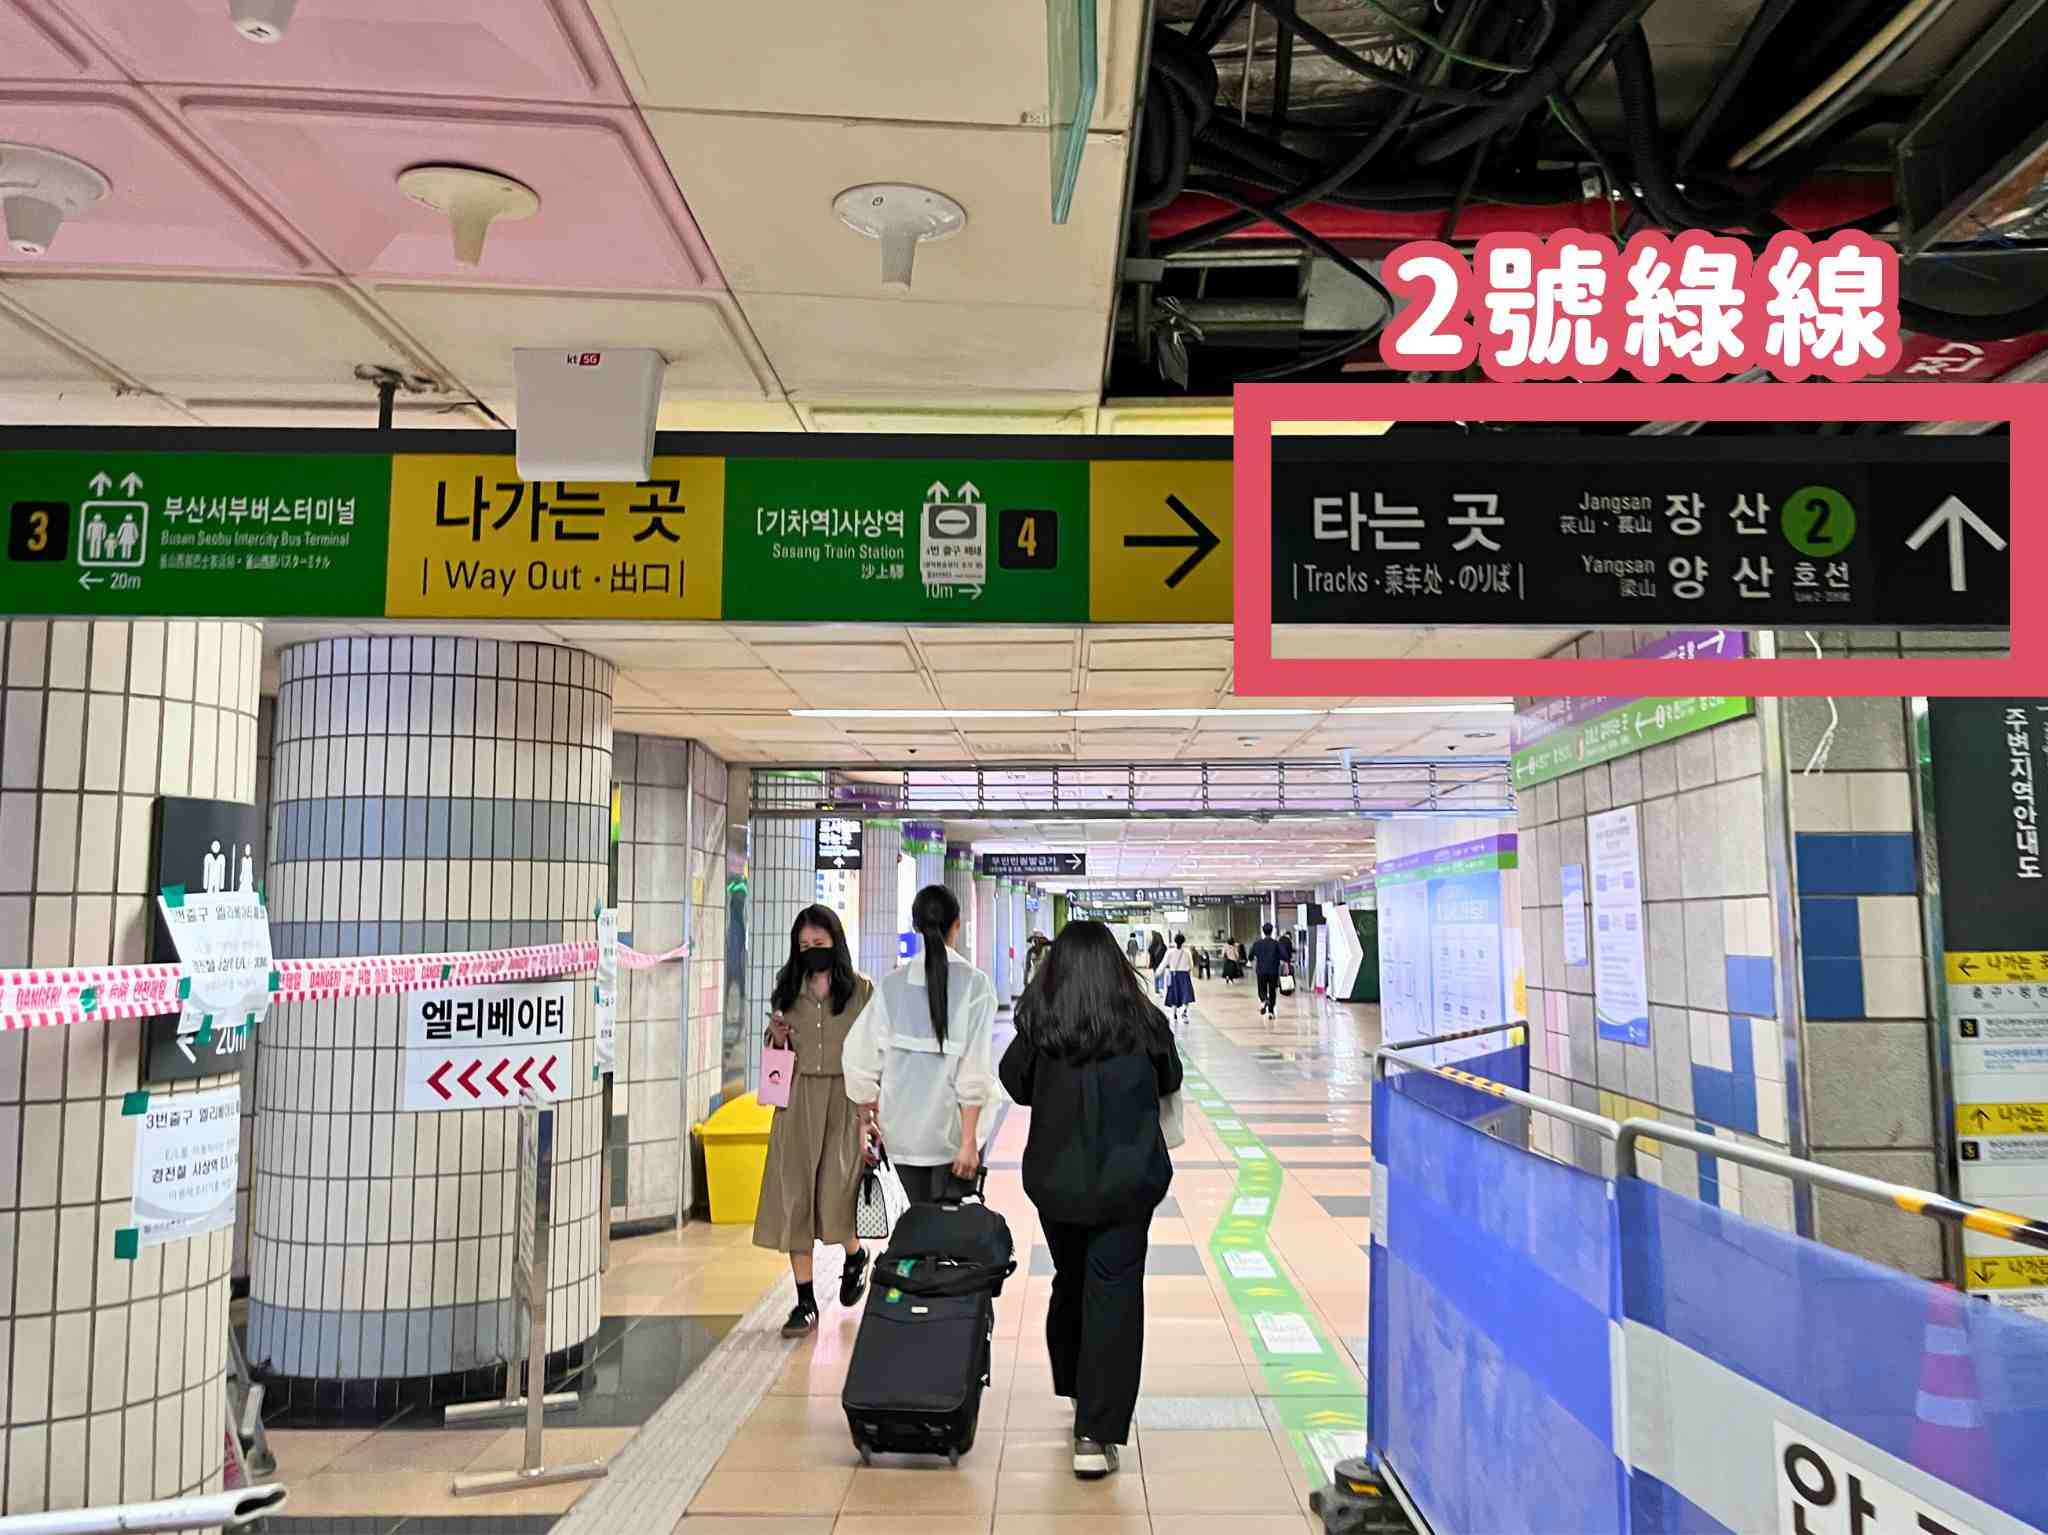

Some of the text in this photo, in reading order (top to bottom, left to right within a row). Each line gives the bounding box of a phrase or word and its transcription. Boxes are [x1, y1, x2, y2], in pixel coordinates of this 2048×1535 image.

[567, 354, 578, 365] kt
[163, 496, 355, 525] 부산서부버스터미널
[436, 476, 685, 542] 나가는 곳
[1579, 492, 1652, 514] Jangsan
[27, 511, 49, 551] 3
[757, 507, 904, 537] [기차역]사상역
[1314, 491, 1504, 551] 타는 곳
[1804, 498, 1833, 545] 2
[305, 532, 350, 547] Terminal
[772, 543, 904, 560] Sasang Train Station
[1018, 517, 1037, 557] 4
[111, 572, 141, 590] 20m
[445, 559, 669, 597] Way Out 出口
[1304, 563, 1369, 593] Tracks
[1458, 563, 1512, 592] のりば
[1582, 554, 1656, 578] Yangsan
[926, 584, 953, 600] 10m
[422, 996, 565, 1040] 엘리베이터
